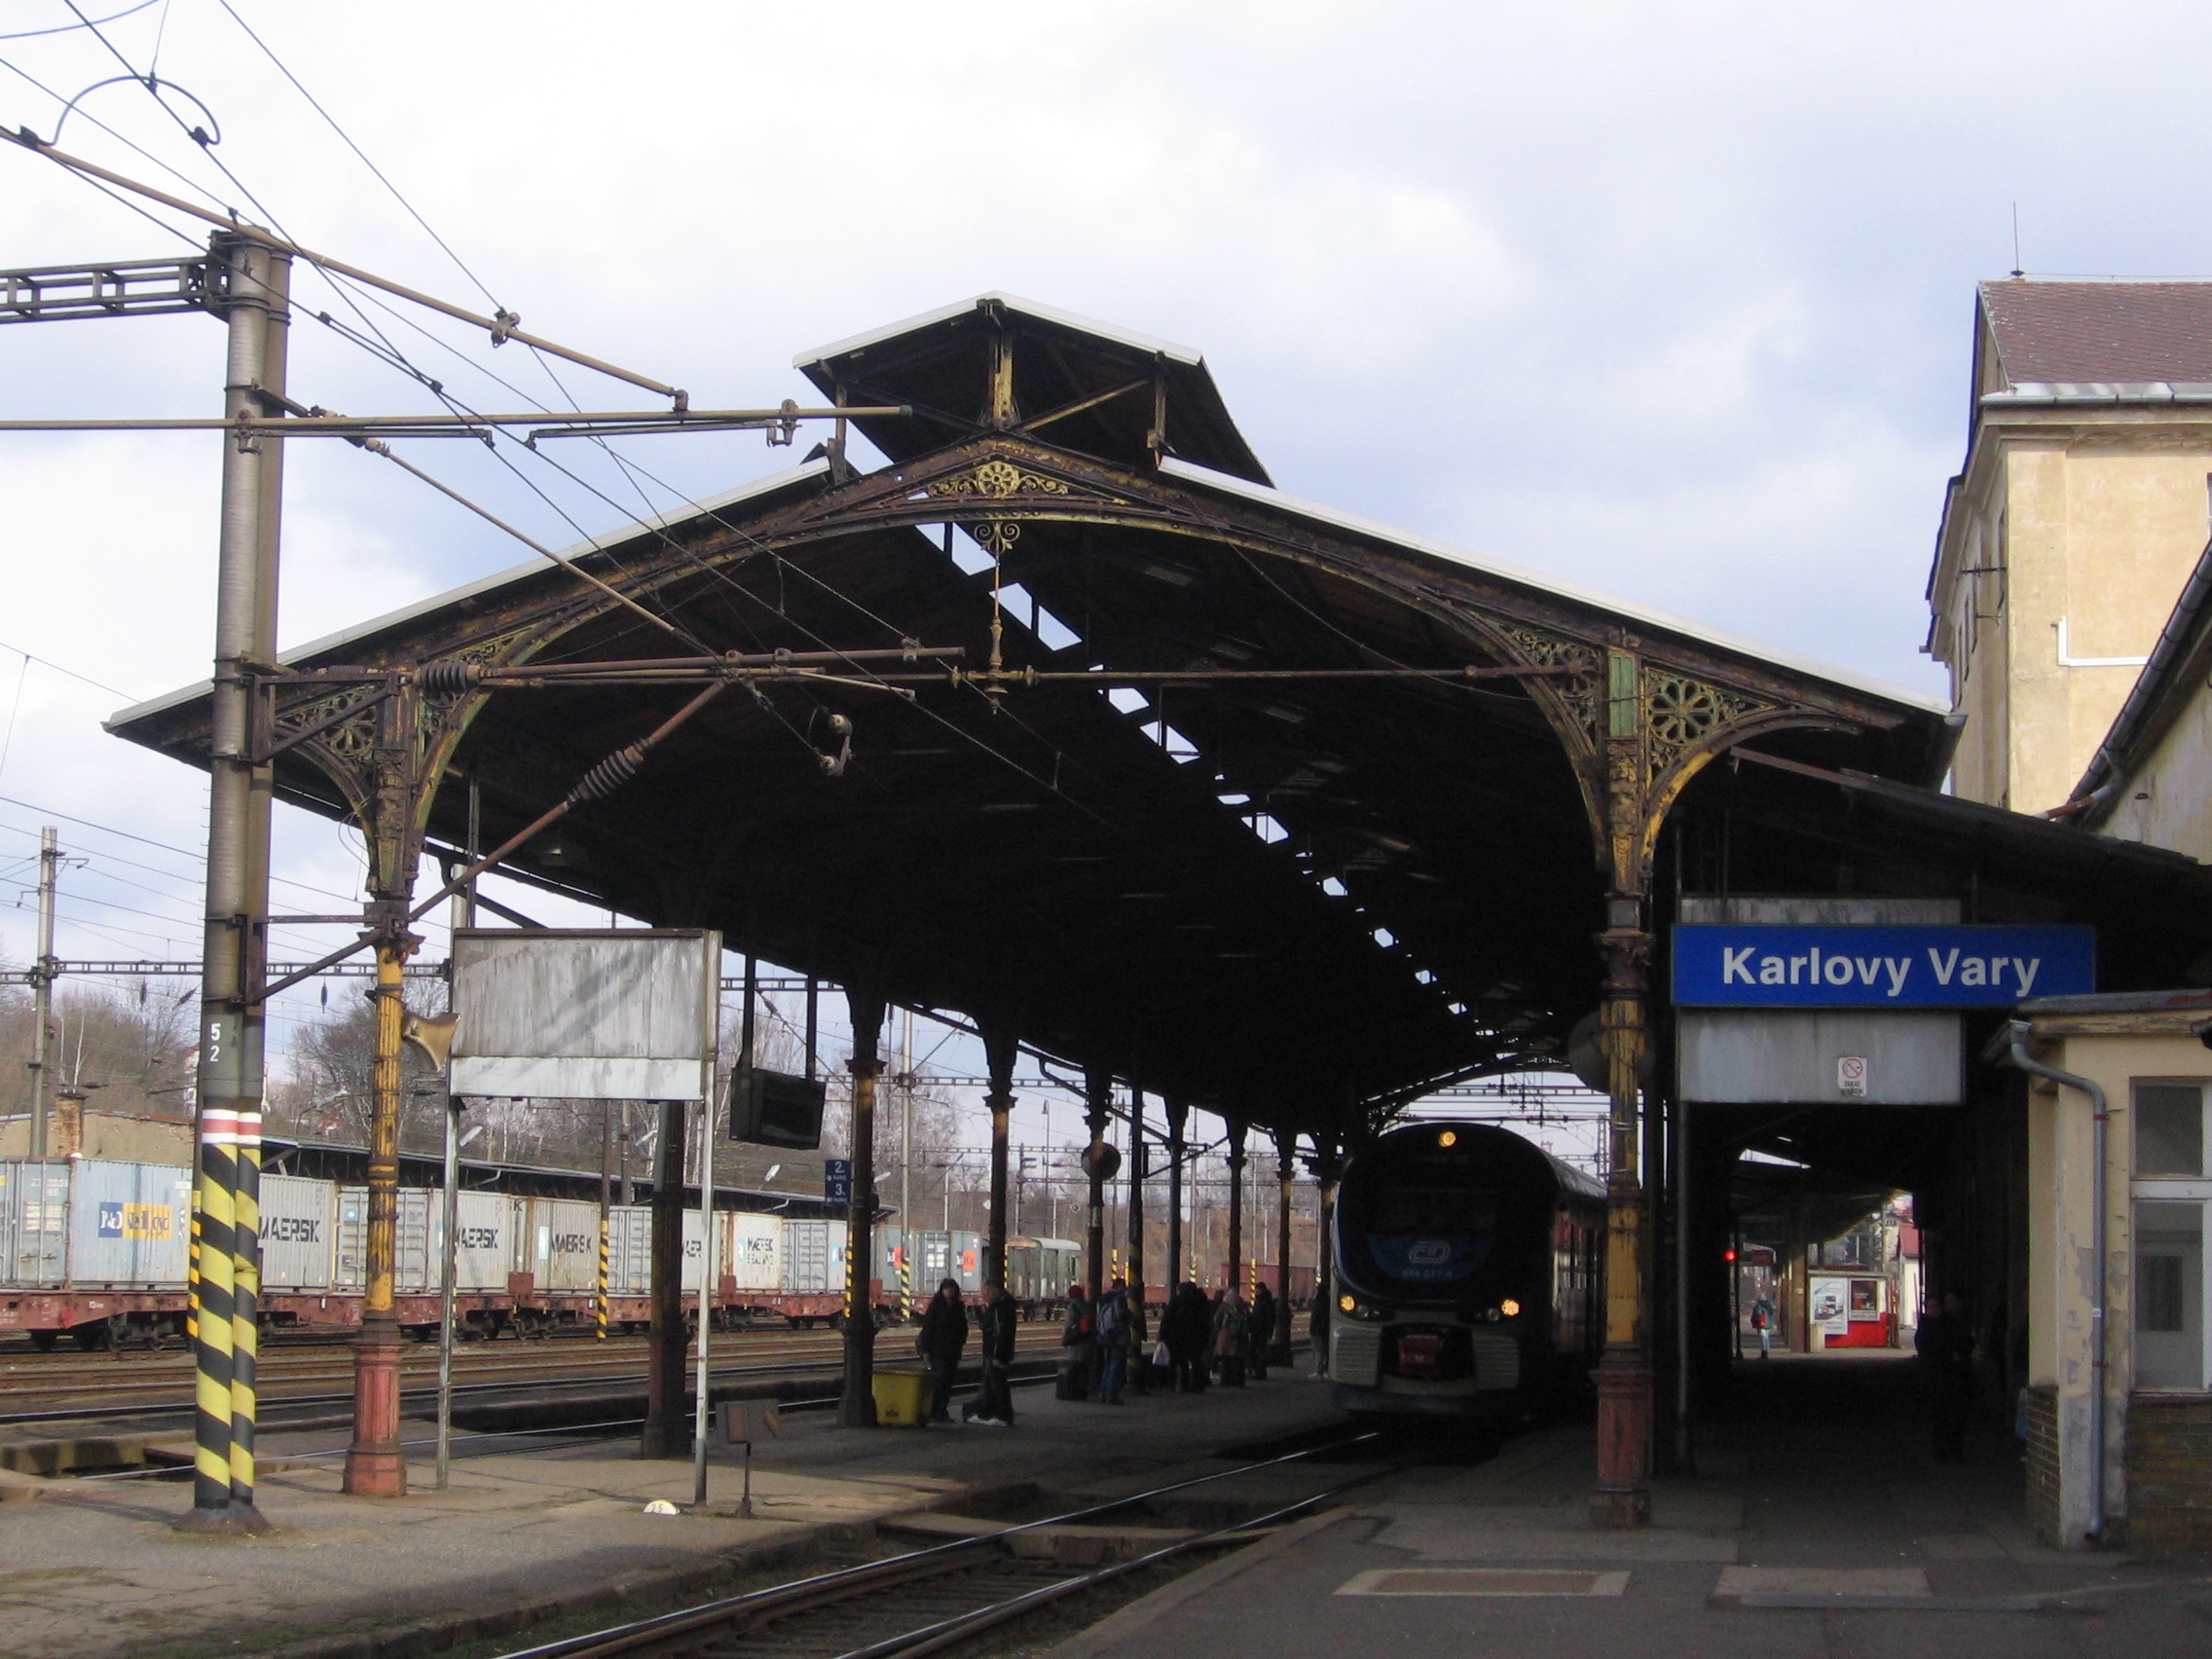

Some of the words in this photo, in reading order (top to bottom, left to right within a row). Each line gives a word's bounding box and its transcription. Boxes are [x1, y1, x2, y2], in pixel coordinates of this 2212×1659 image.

[1722, 947, 1911, 997] Karlovy
[1928, 947, 2040, 997] Vary
[210, 1022, 221, 1041] 5
[209, 1045, 220, 1062] 2
[258, 1216, 320, 1242] MAERSK
[551, 1234, 592, 1254] MAERSK
